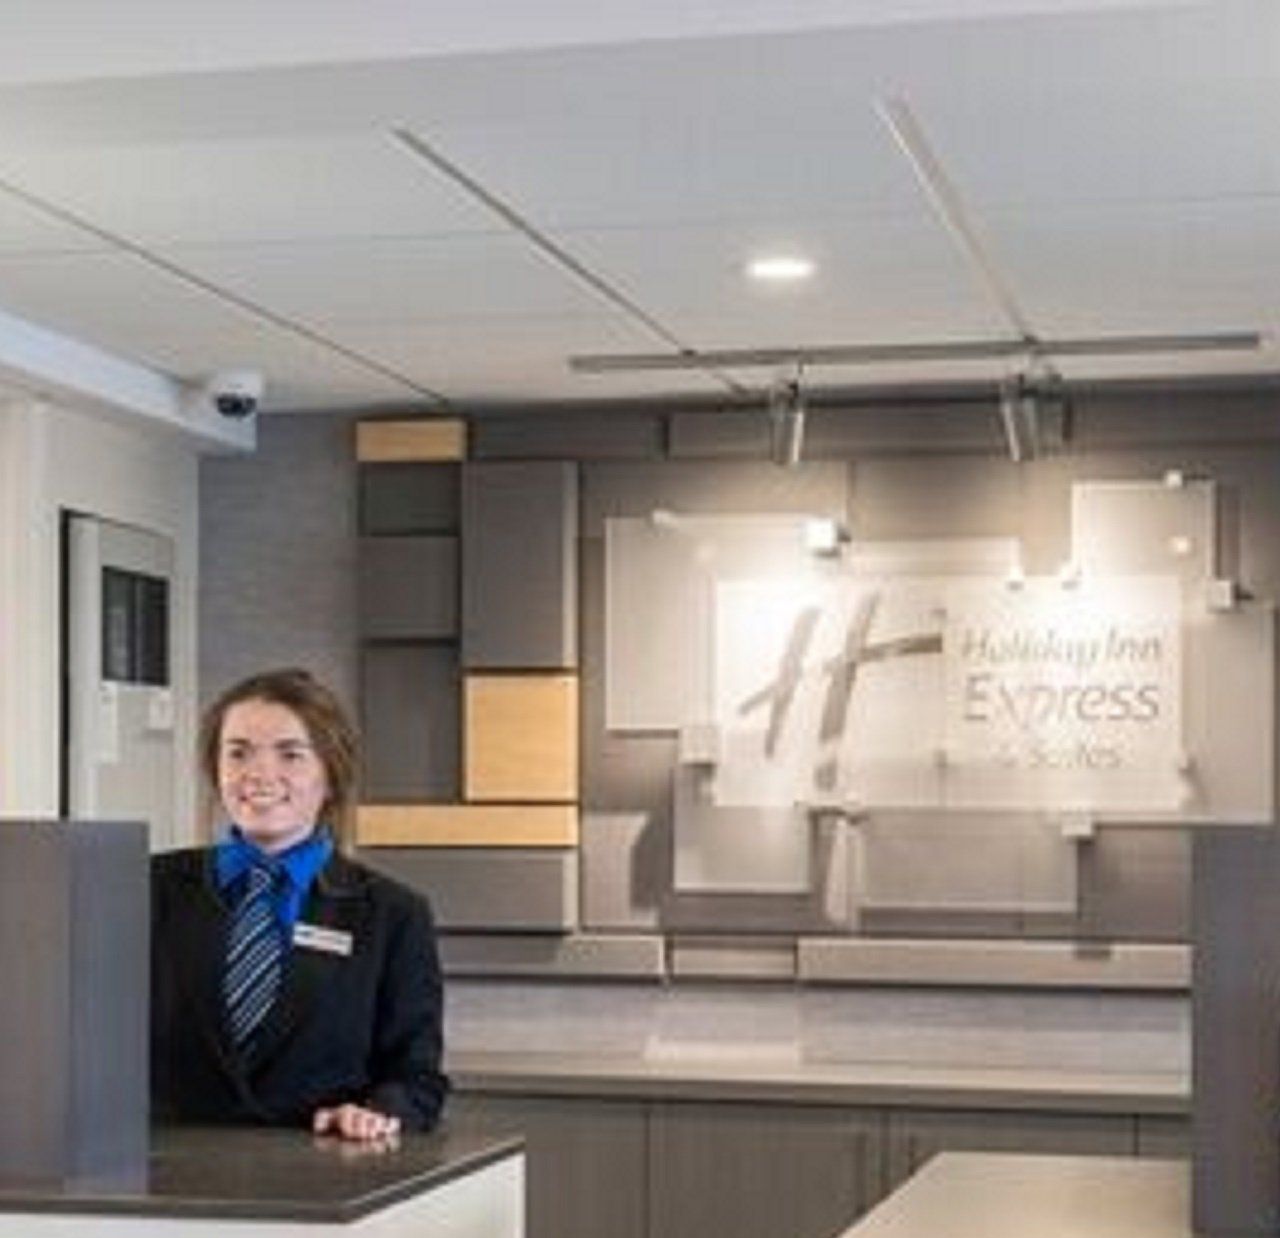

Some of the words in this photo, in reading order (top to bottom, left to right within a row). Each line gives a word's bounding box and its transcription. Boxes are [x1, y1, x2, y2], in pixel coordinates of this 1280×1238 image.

[961, 628, 1101, 668] Holiday
[1105, 627, 1162, 662] Inn
[962, 671, 1161, 731] Express
